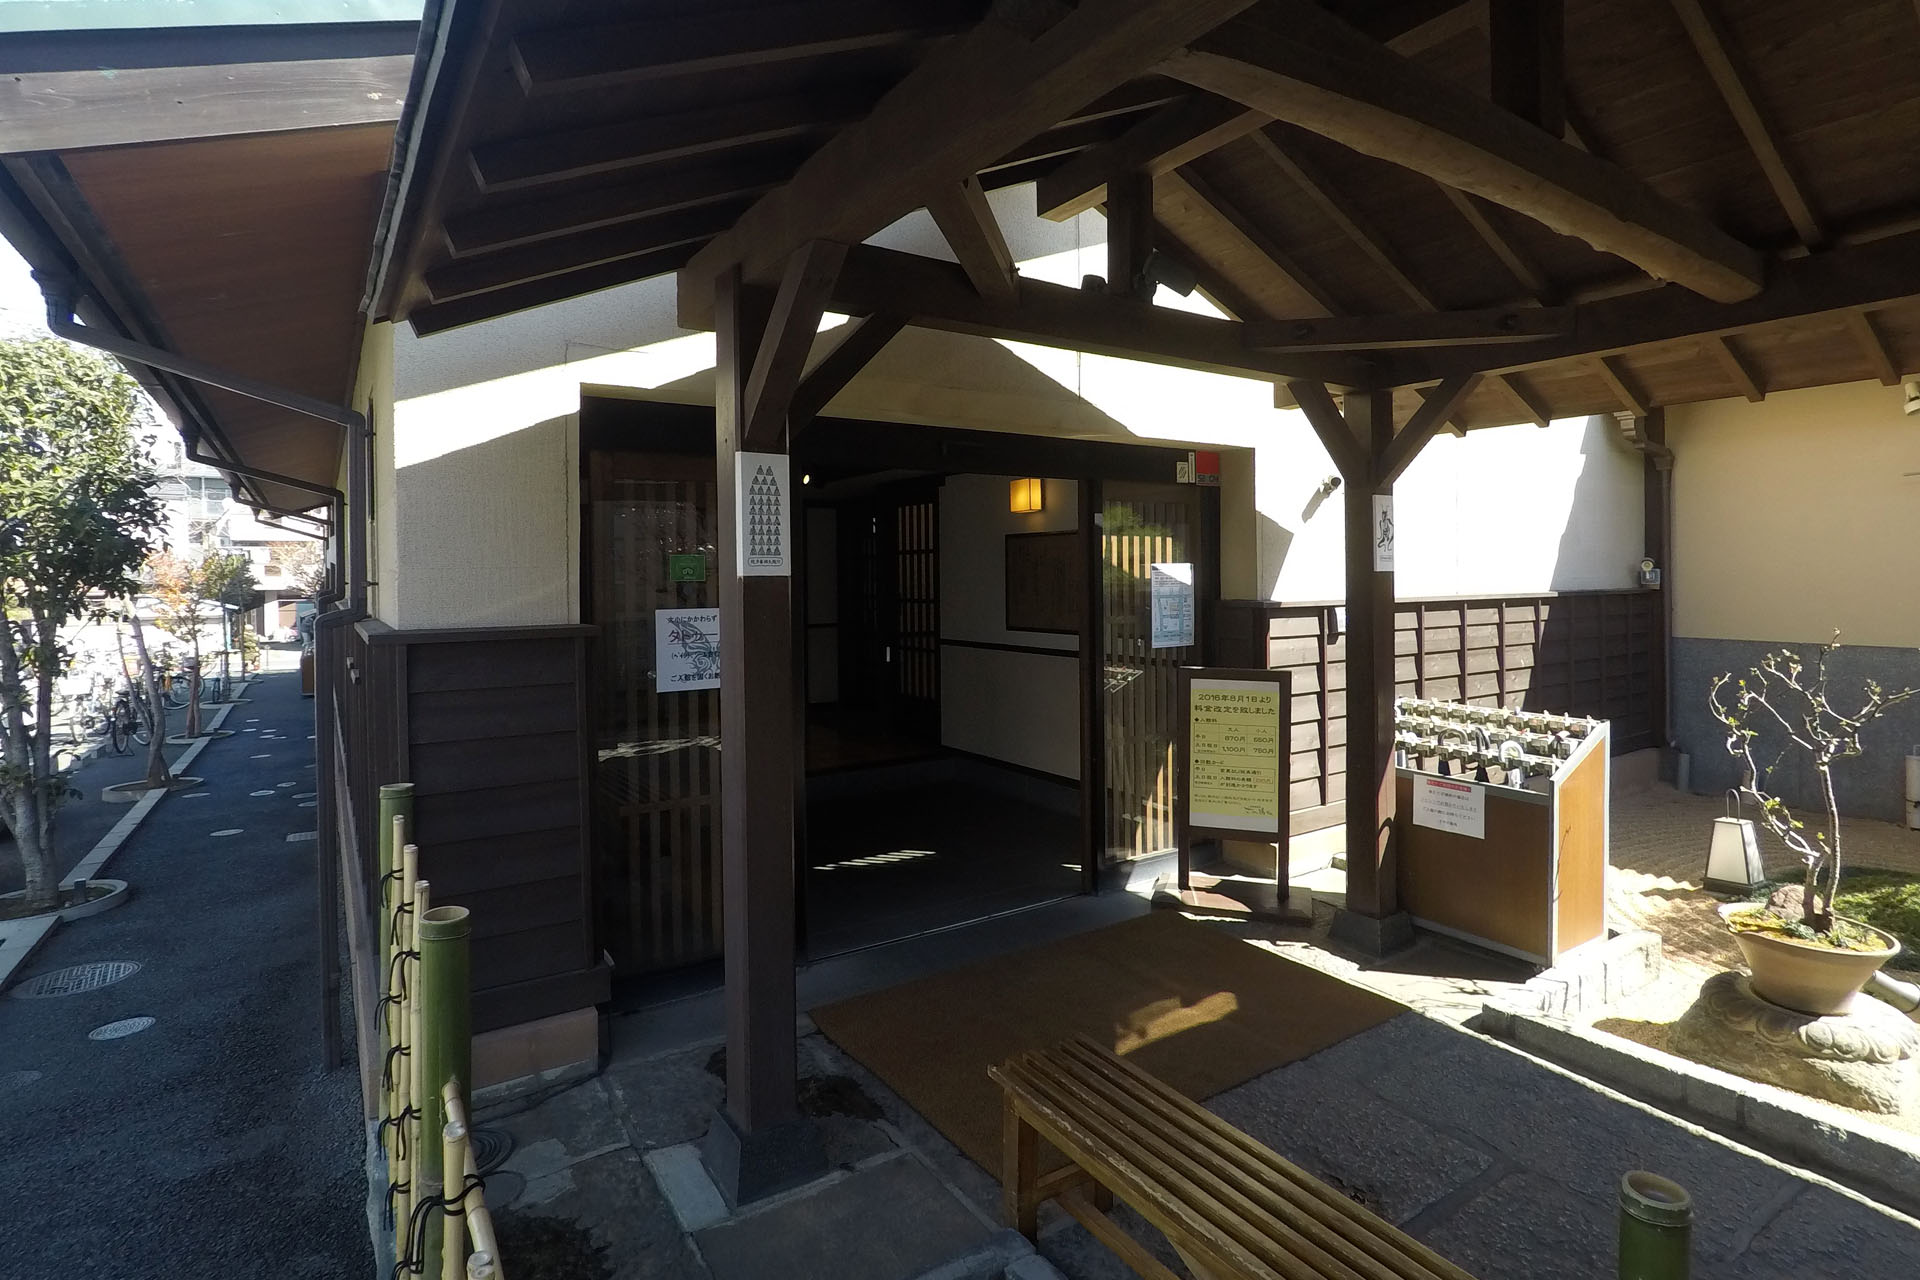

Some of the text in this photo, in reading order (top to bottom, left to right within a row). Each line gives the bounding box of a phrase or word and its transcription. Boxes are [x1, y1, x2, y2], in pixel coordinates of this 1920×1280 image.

[1198, 693, 1272, 704] 2016年8月1日より
[1194, 704, 1276, 715] 料金改定を致しました
